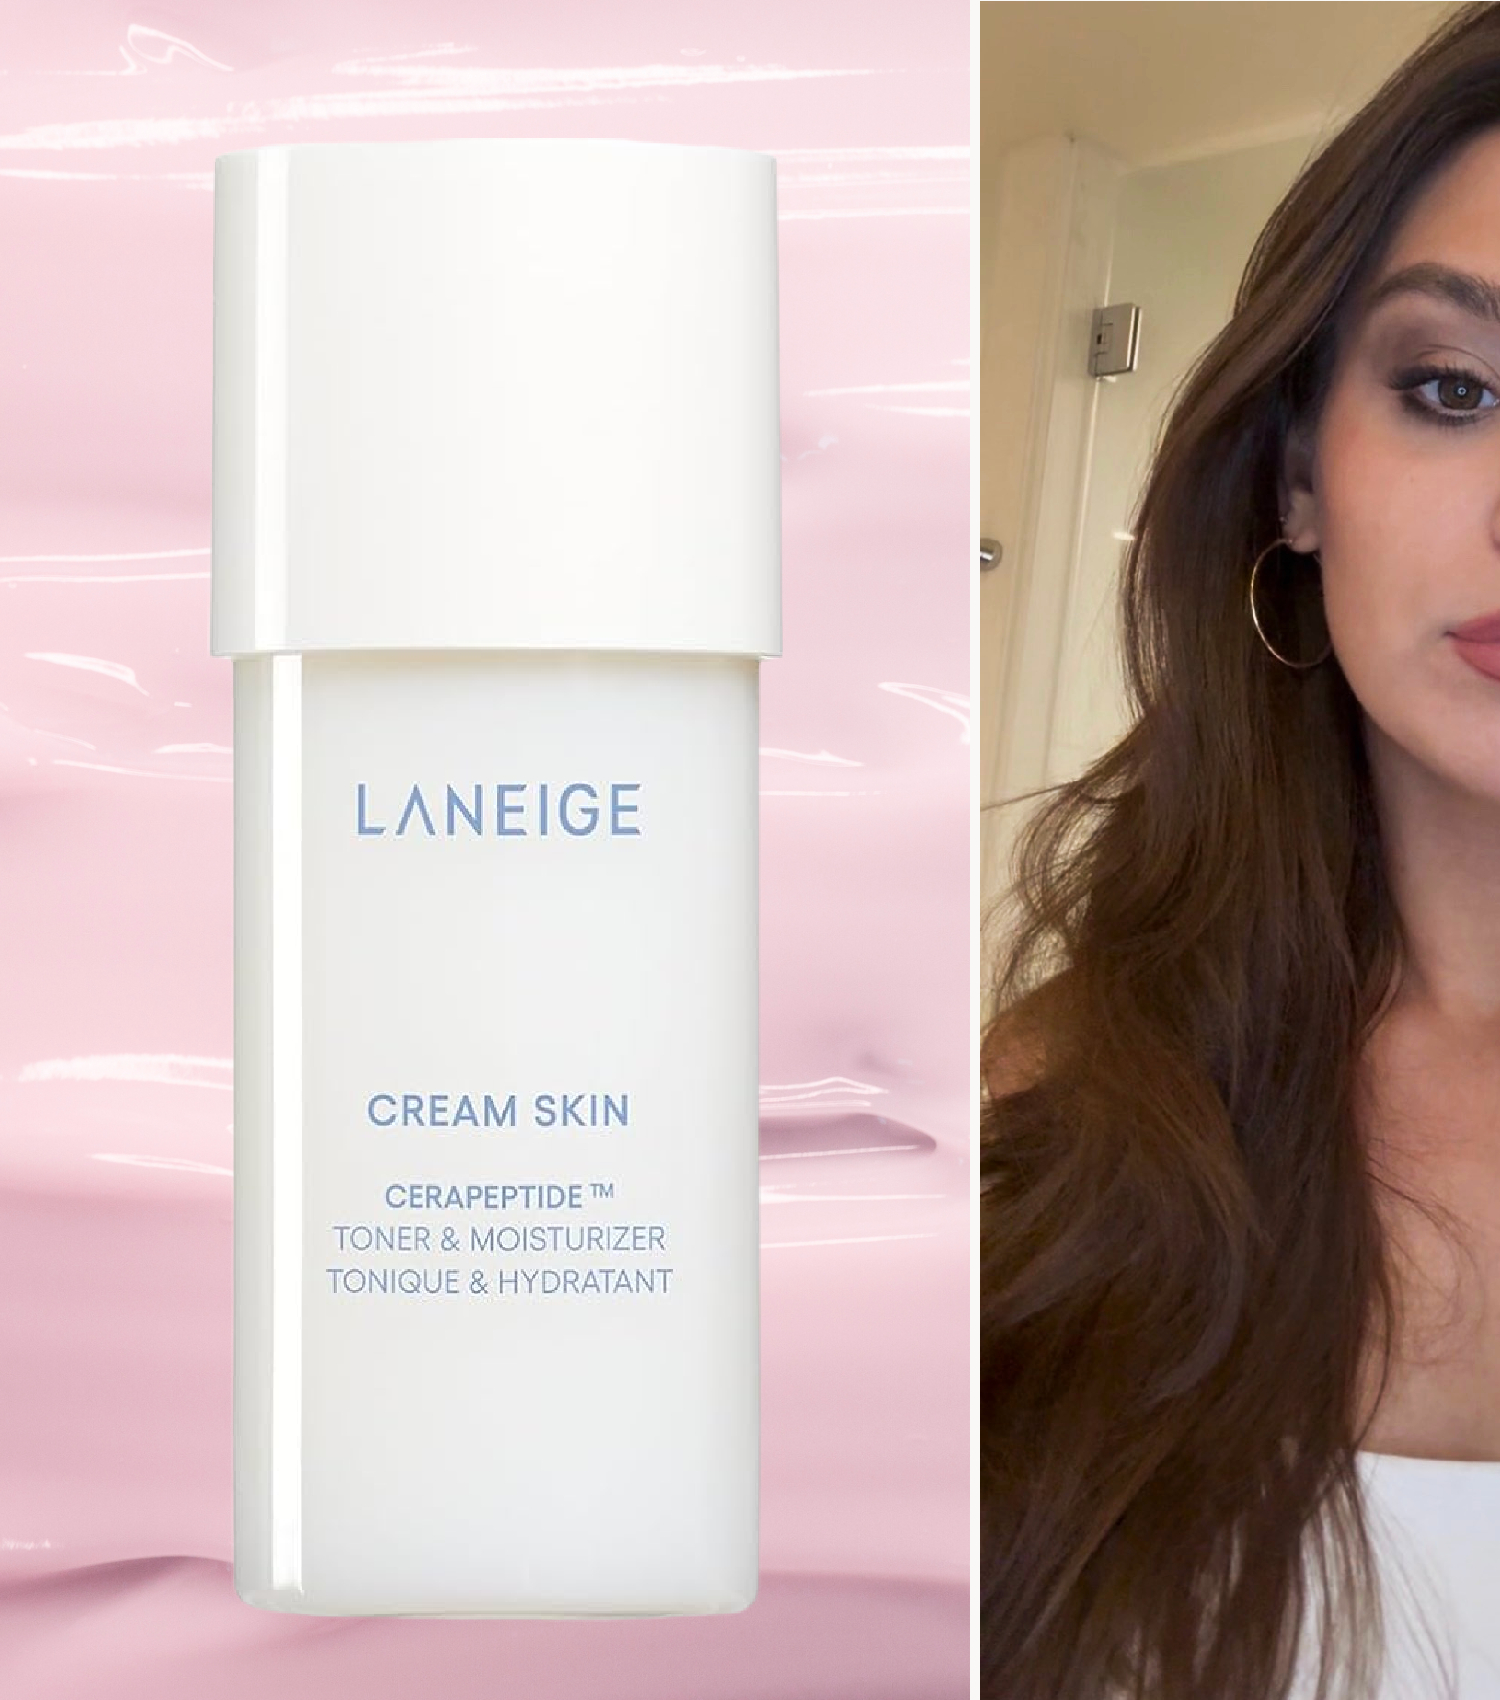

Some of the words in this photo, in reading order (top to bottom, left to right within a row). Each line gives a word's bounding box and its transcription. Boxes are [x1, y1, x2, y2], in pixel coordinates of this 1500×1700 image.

[357, 783, 641, 837] LANEIGE
[367, 1094, 517, 1127] CREAM
[534, 1094, 629, 1127] SKIN
[385, 1183, 583, 1209] CERAPEPTIDE
[334, 1226, 431, 1251] TONER
[440, 1226, 460, 1252] &
[470, 1225, 665, 1251] MOISTURIZER
[326, 1268, 460, 1295] TONIQUE
[469, 1269, 489, 1295] &
[499, 1268, 674, 1294] HYDRATANT
